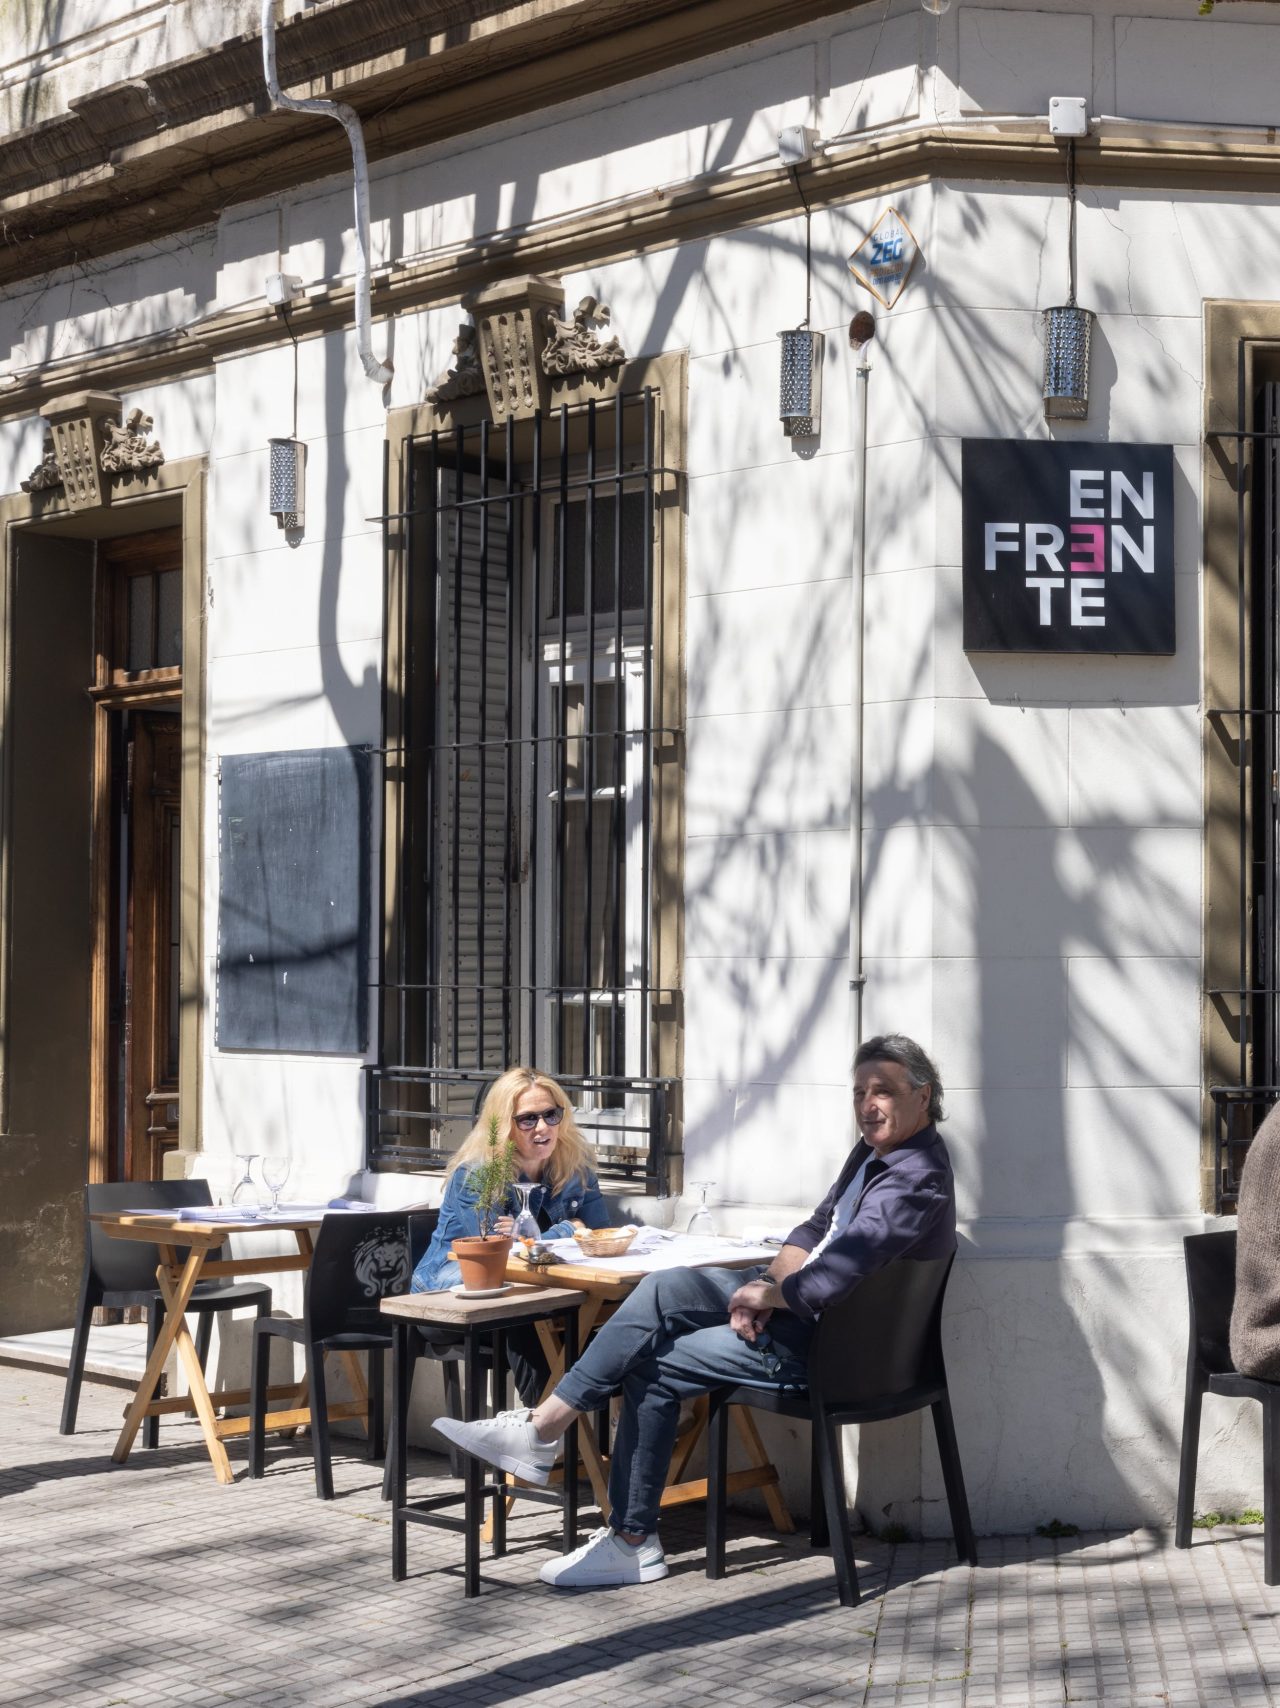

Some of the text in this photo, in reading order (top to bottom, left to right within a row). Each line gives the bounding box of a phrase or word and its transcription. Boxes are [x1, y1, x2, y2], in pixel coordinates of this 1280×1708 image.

[873, 228, 904, 241] GLOBAL
[1070, 469, 1155, 519] EN
[1025, 577, 1106, 627] TE
